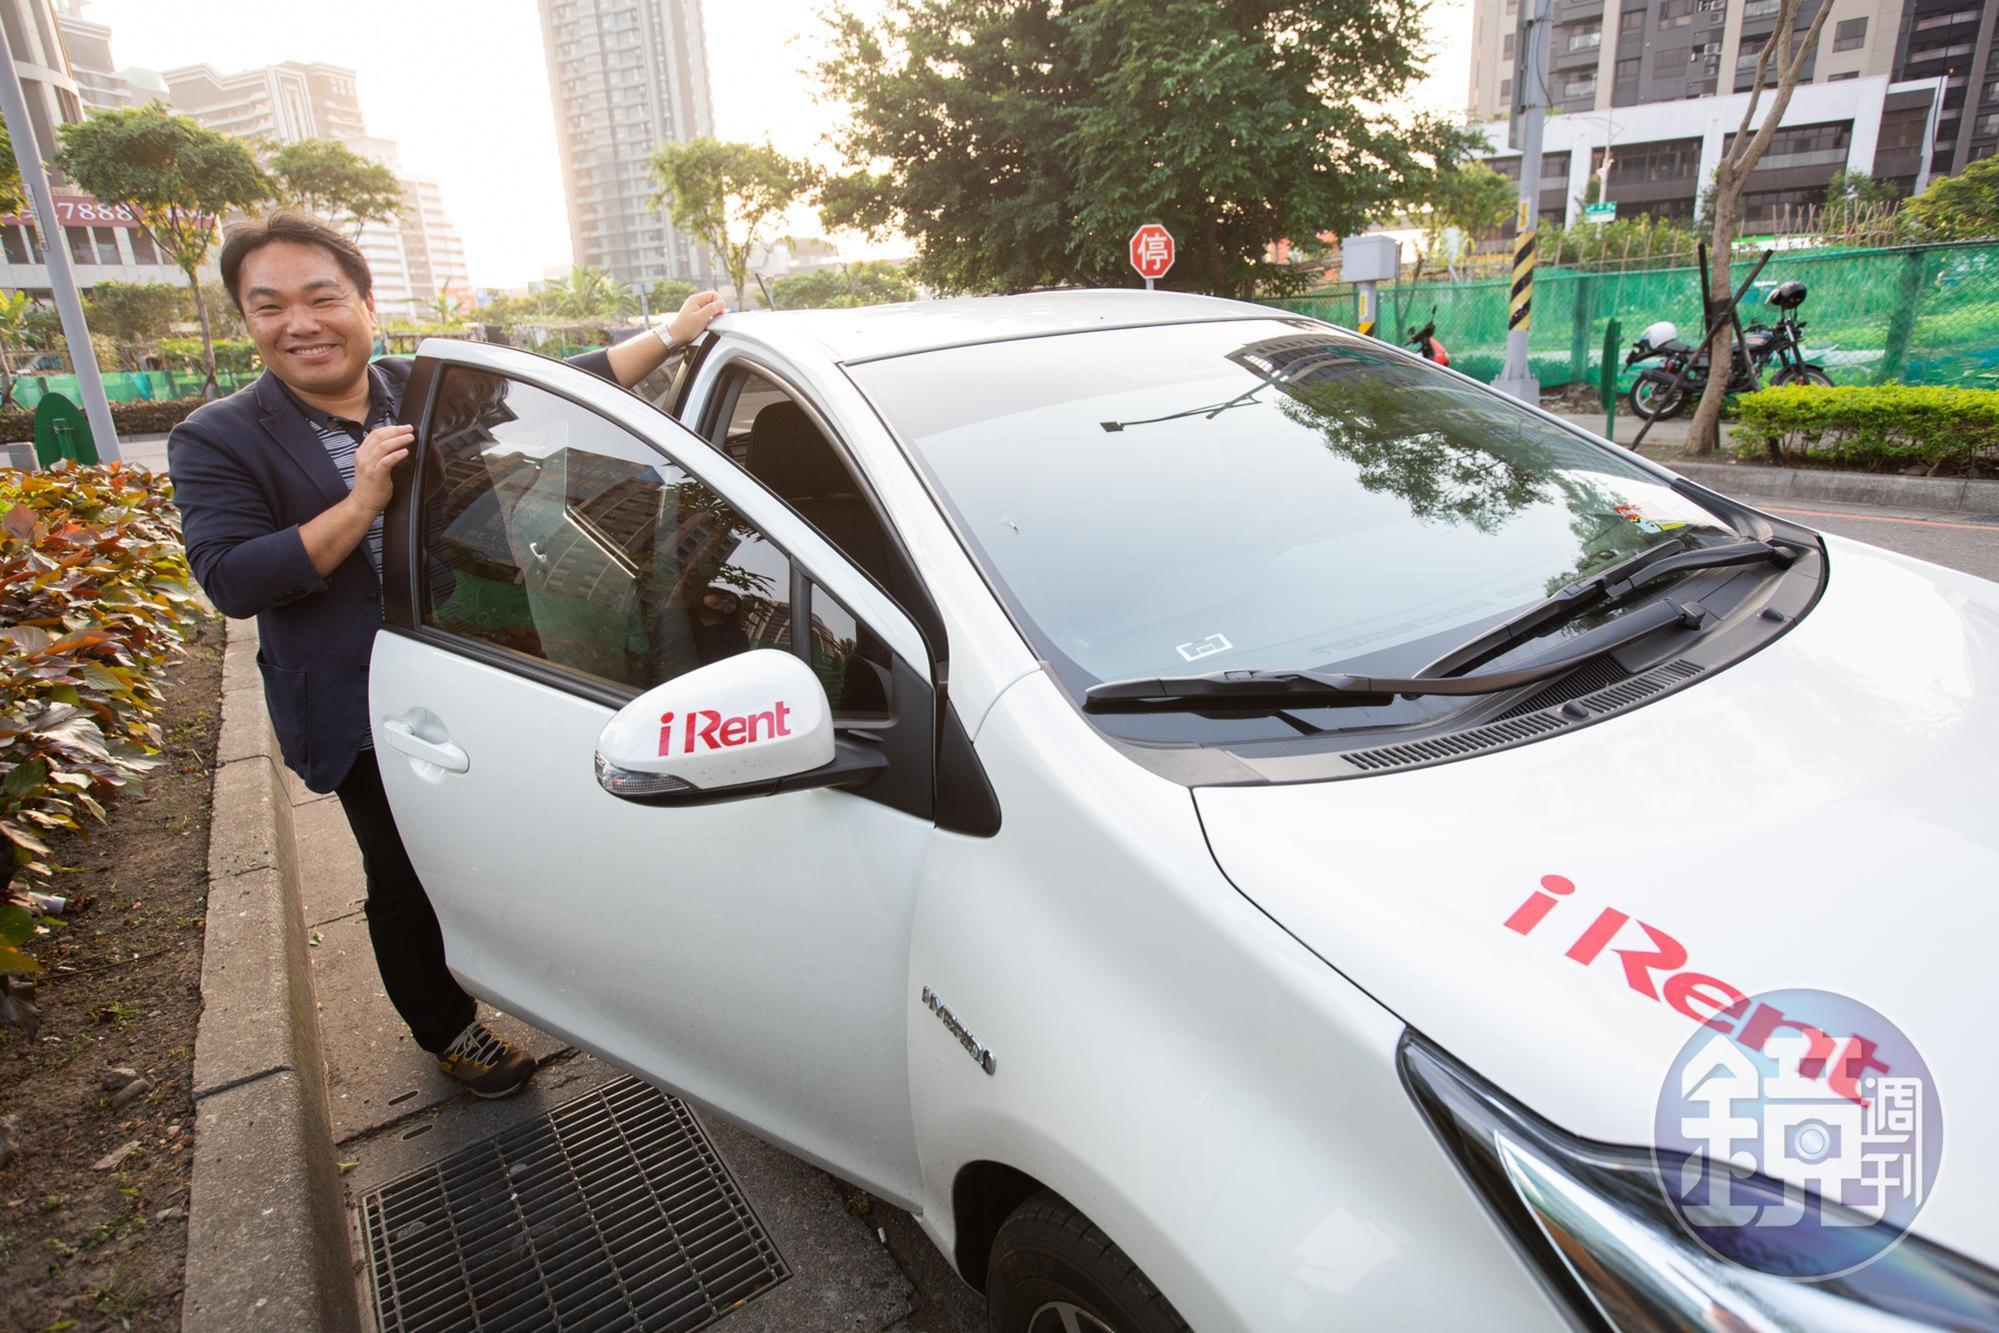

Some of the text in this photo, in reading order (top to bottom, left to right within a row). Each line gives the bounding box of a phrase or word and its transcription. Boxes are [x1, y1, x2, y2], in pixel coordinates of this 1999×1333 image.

[1137, 232, 1168, 271] 停
[684, 701, 791, 754] Rent
[1564, 906, 1891, 1110] Rent
